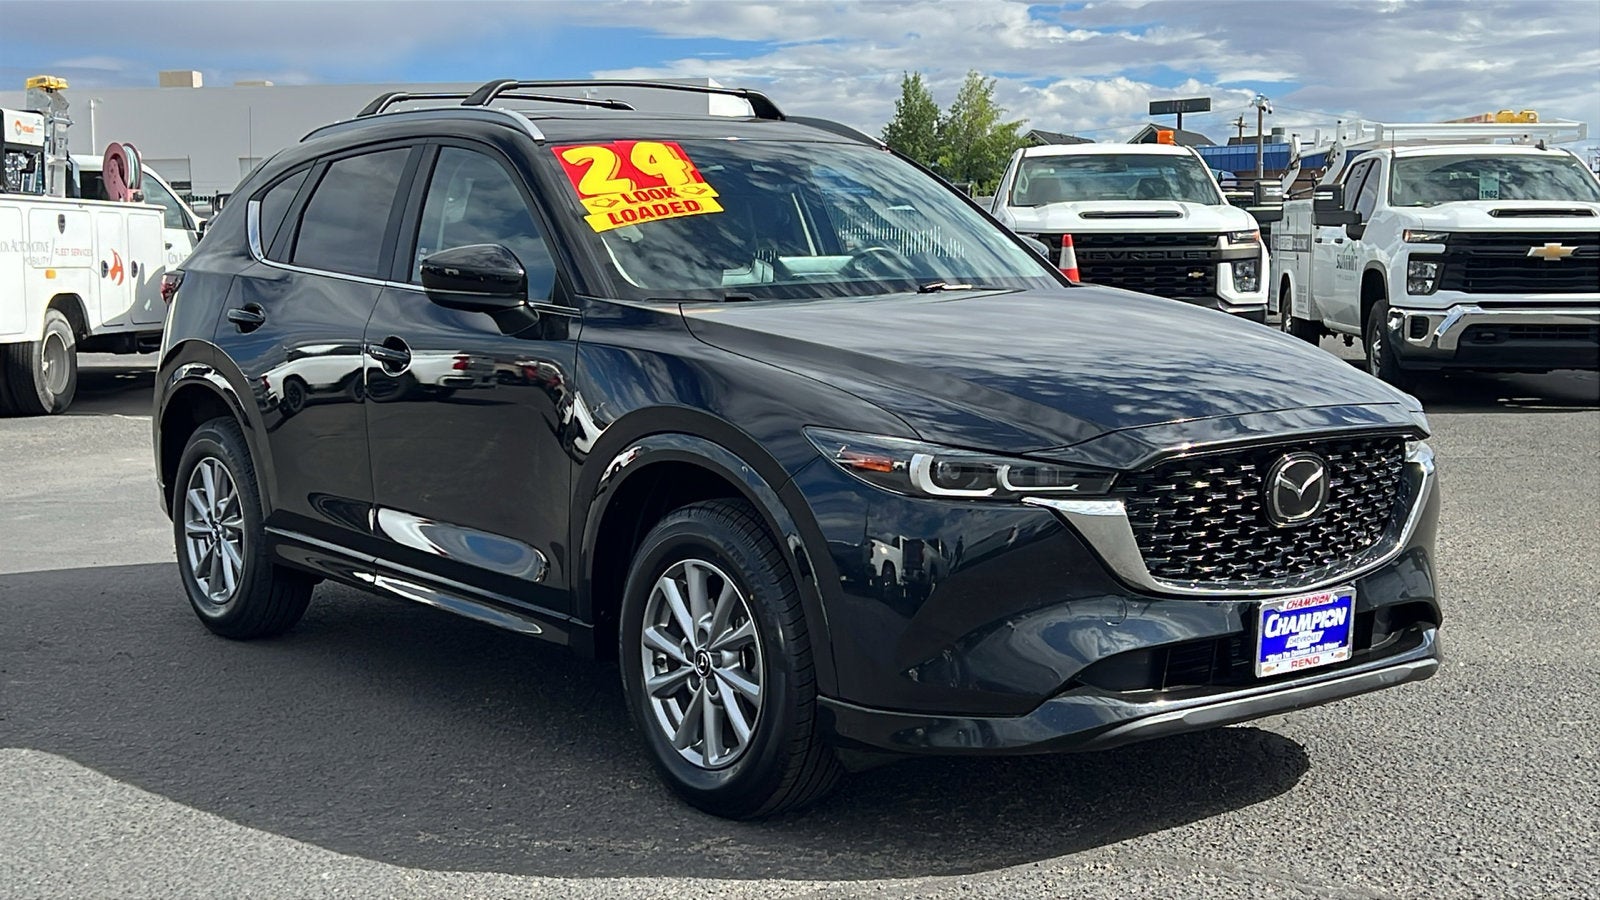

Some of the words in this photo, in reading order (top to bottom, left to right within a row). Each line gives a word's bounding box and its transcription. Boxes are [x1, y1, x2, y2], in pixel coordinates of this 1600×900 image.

[561, 141, 694, 196] 24
[620, 187, 680, 204] LOOK
[607, 200, 701, 225] LOADED
[1286, 594, 1332, 609] CHAMPION
[1265, 607, 1347, 638] CHAMPION
[1289, 633, 1321, 645] CHEVROLET
[1291, 656, 1320, 669] RENO
